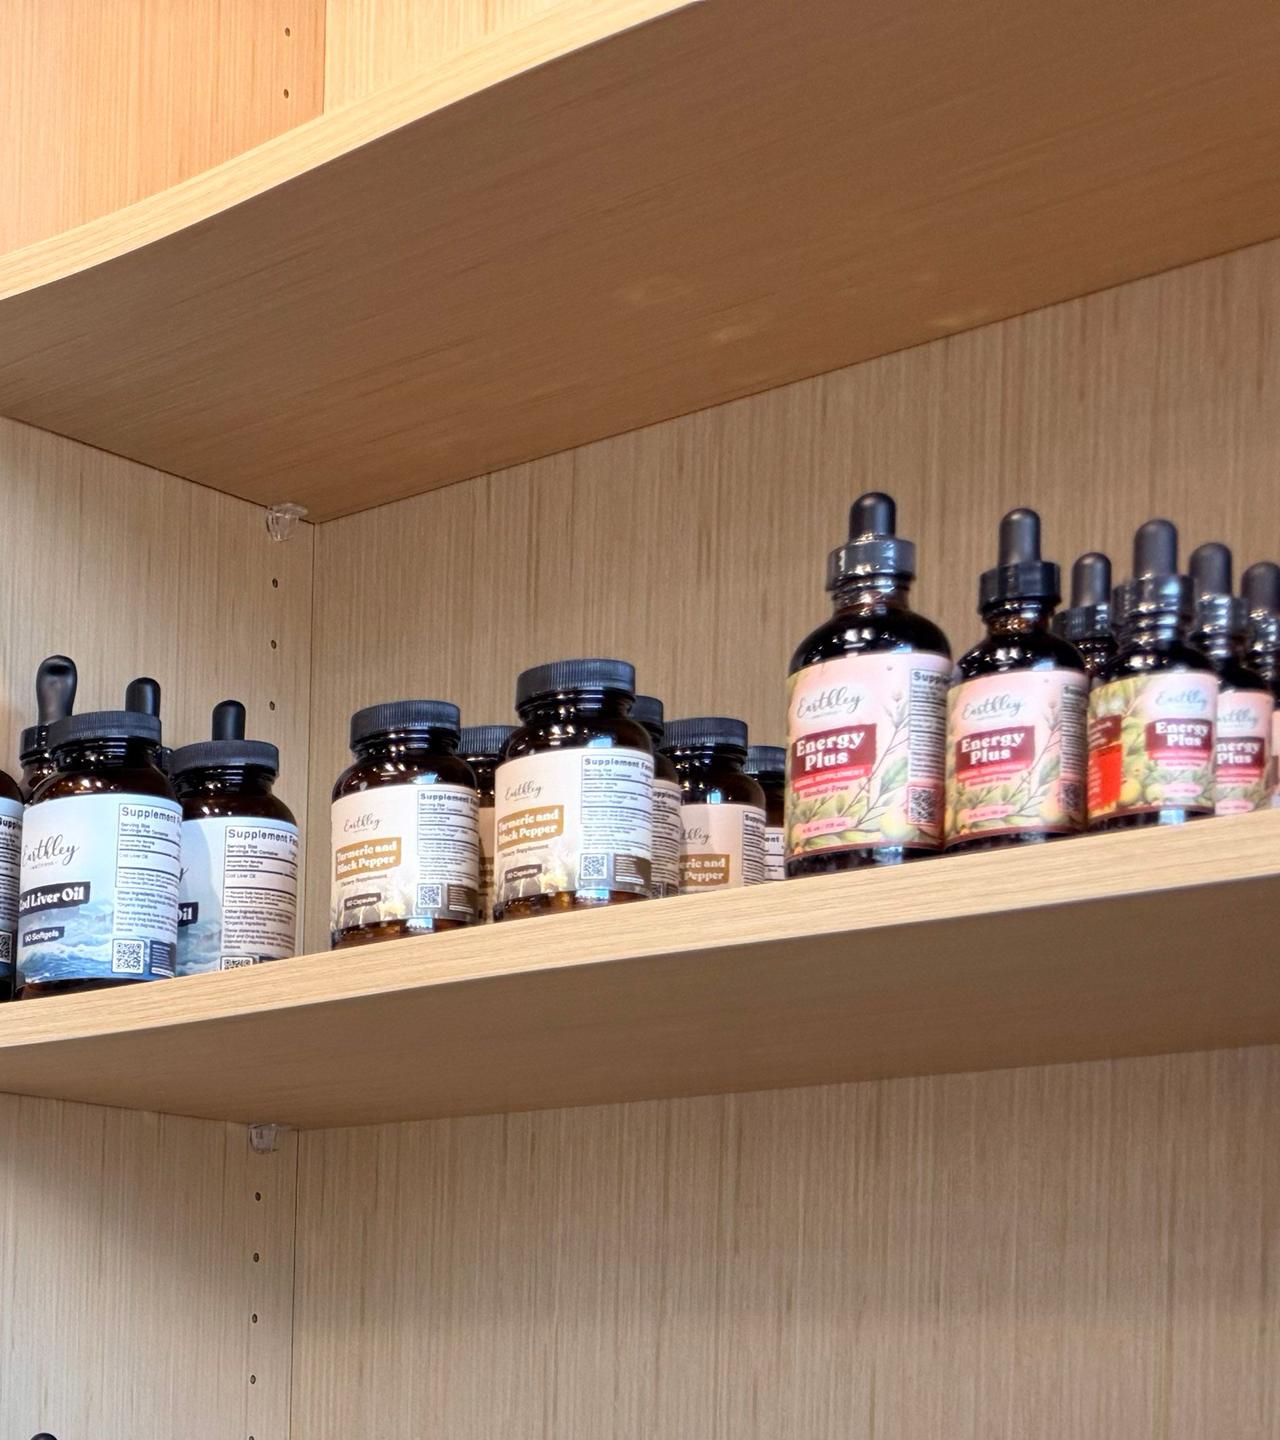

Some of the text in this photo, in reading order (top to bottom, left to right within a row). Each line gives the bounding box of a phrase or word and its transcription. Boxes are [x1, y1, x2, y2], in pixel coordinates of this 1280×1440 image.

[1155, 721, 1210, 736] Energy
[796, 731, 865, 757] Energy
[961, 732, 1025, 752] Energy
[1167, 734, 1202, 747] Plus
[1217, 741, 1261, 754] nergy
[584, 758, 640, 769] Supplement
[805, 752, 849, 771] Plus
[970, 749, 1011, 765] Plus
[1217, 752, 1252, 765] Plus
[420, 793, 469, 803] Supplement
[121, 806, 177, 823] Supplement
[498, 809, 559, 832] Turmeric and
[227, 829, 289, 843] Supplement
[519, 824, 557, 838] Pepper
[337, 841, 397, 861] Turmeric and
[359, 856, 396, 870] Pepper
[704, 858, 726, 869] and
[684, 871, 724, 883] Pepper
[31, 890, 61, 905] Liver
[62, 885, 84, 901] Oil
